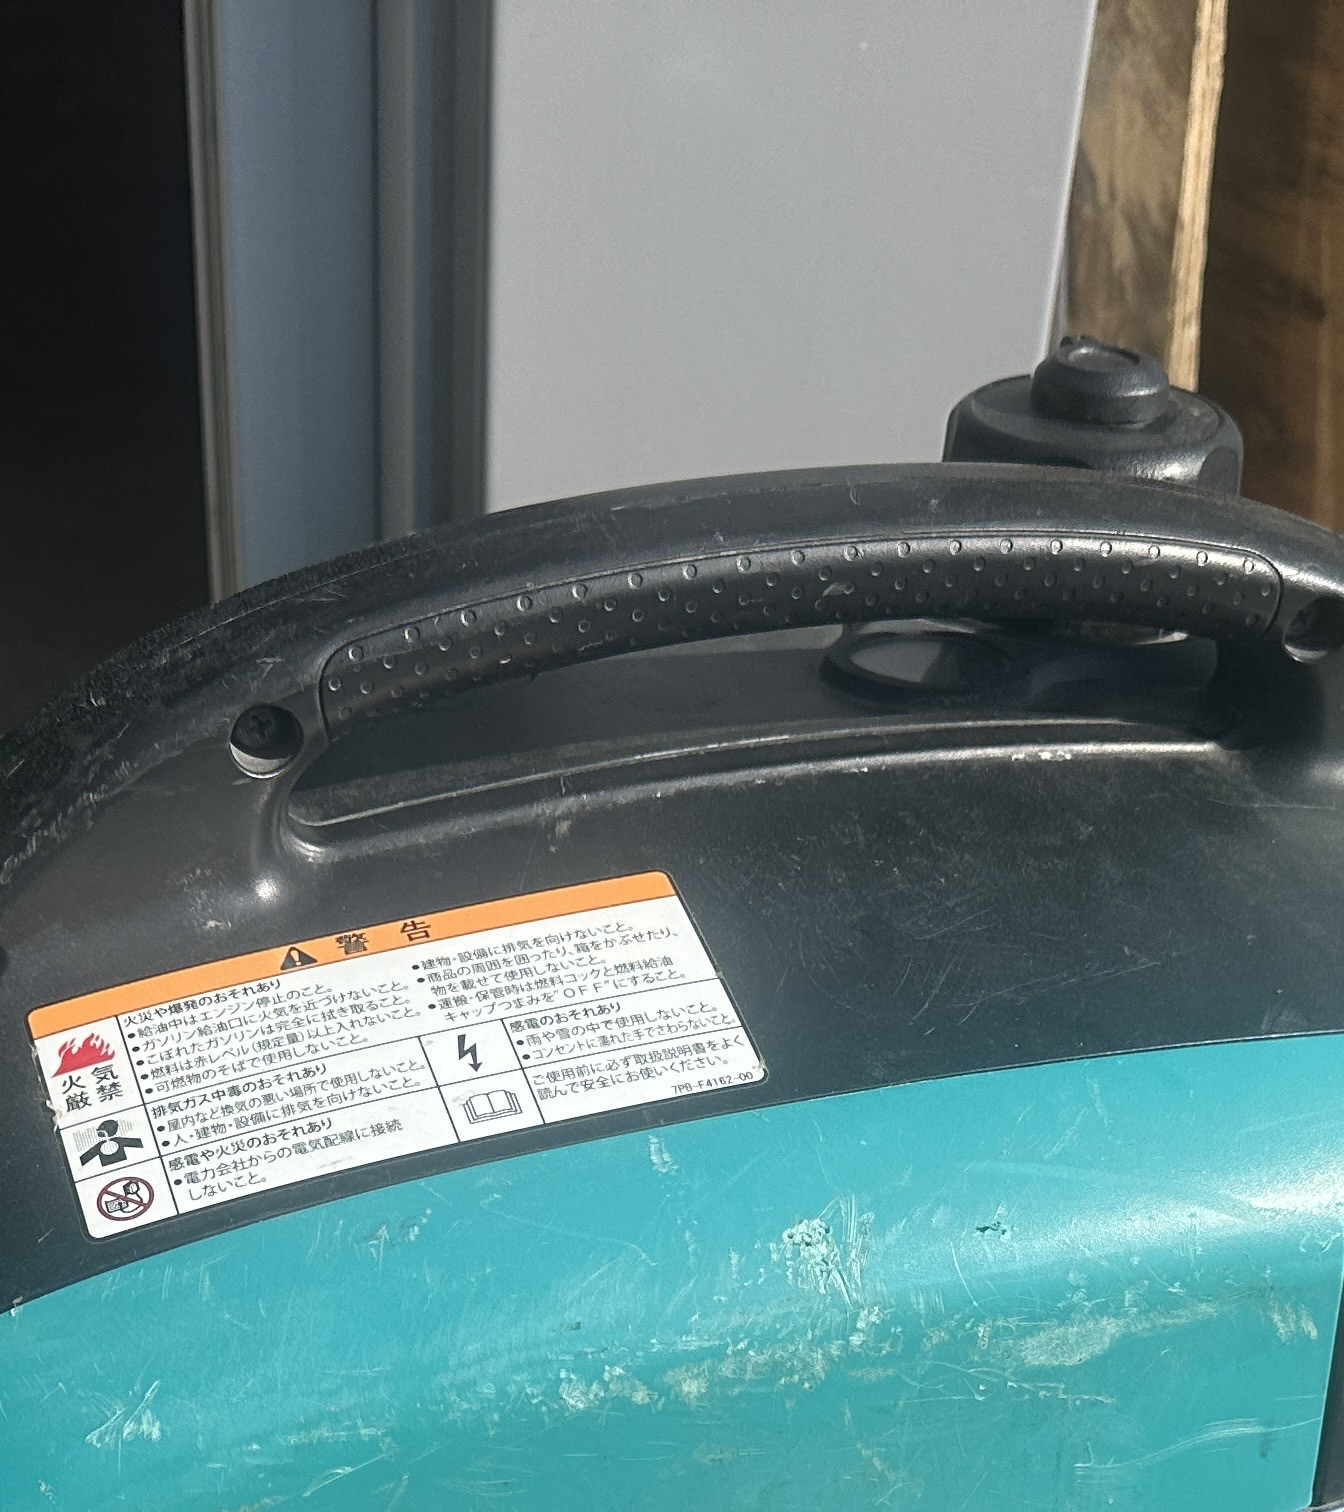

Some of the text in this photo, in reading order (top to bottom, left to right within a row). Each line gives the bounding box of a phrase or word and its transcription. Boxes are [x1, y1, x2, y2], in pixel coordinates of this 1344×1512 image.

[335, 920, 433, 955] 警告
[124, 979, 281, 1026] 火災や爆発のおそれあり
[138, 985, 333, 1037] 給油中はエンジン停止のこと。
[510, 1002, 622, 1033] 感電のおそれあり
[155, 1037, 368, 1093] 可燃物のそばで使用しないこと。
[152, 1063, 327, 1120] 排気ガス中毒のおそれあり
[169, 1117, 333, 1170] 感電や火災のおそれあり
[184, 1119, 403, 1185] 電力会社からの電気配線に接続
[188, 1174, 268, 1201] しないこと。
